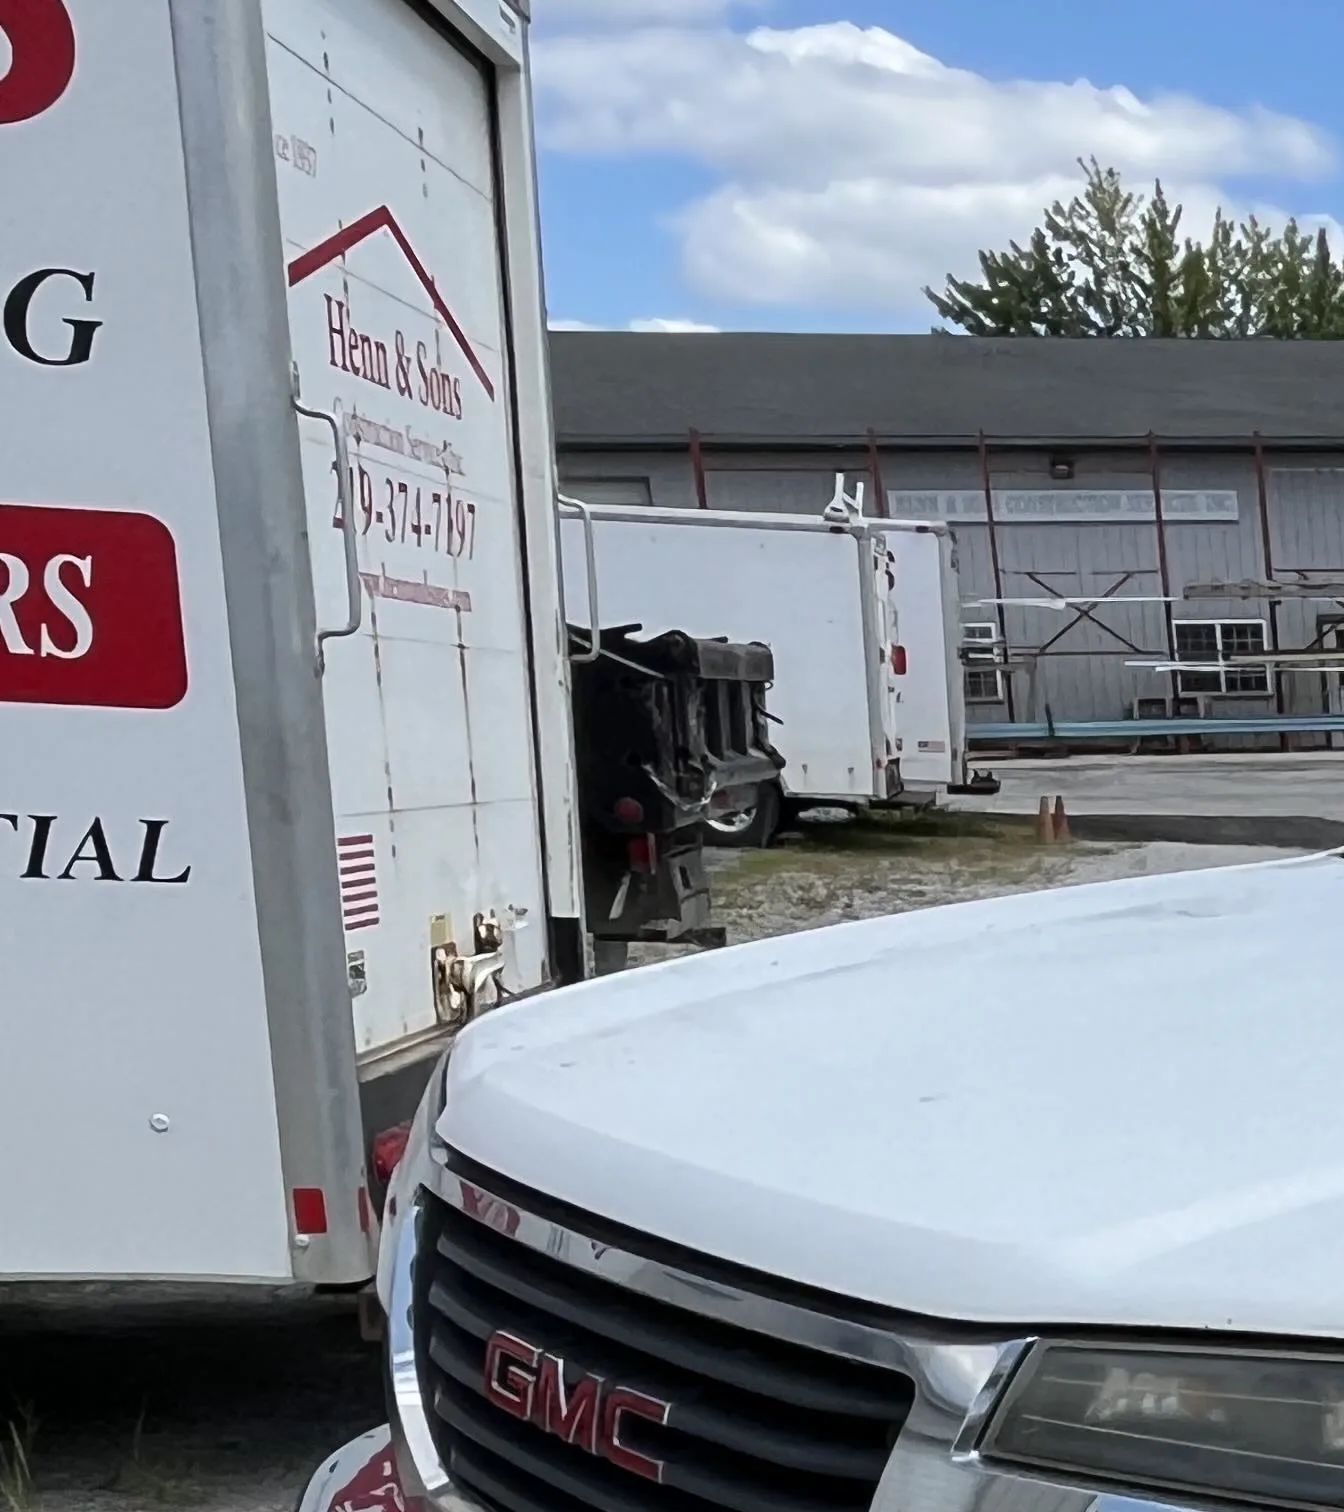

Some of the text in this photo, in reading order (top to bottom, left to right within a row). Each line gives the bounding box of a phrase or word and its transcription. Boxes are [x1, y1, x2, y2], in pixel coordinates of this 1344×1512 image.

[3, 268, 103, 366] G
[324, 293, 462, 420] Henn & Sons
[0, 813, 191, 883] IAL
[484, 1330, 672, 1483] GMC
